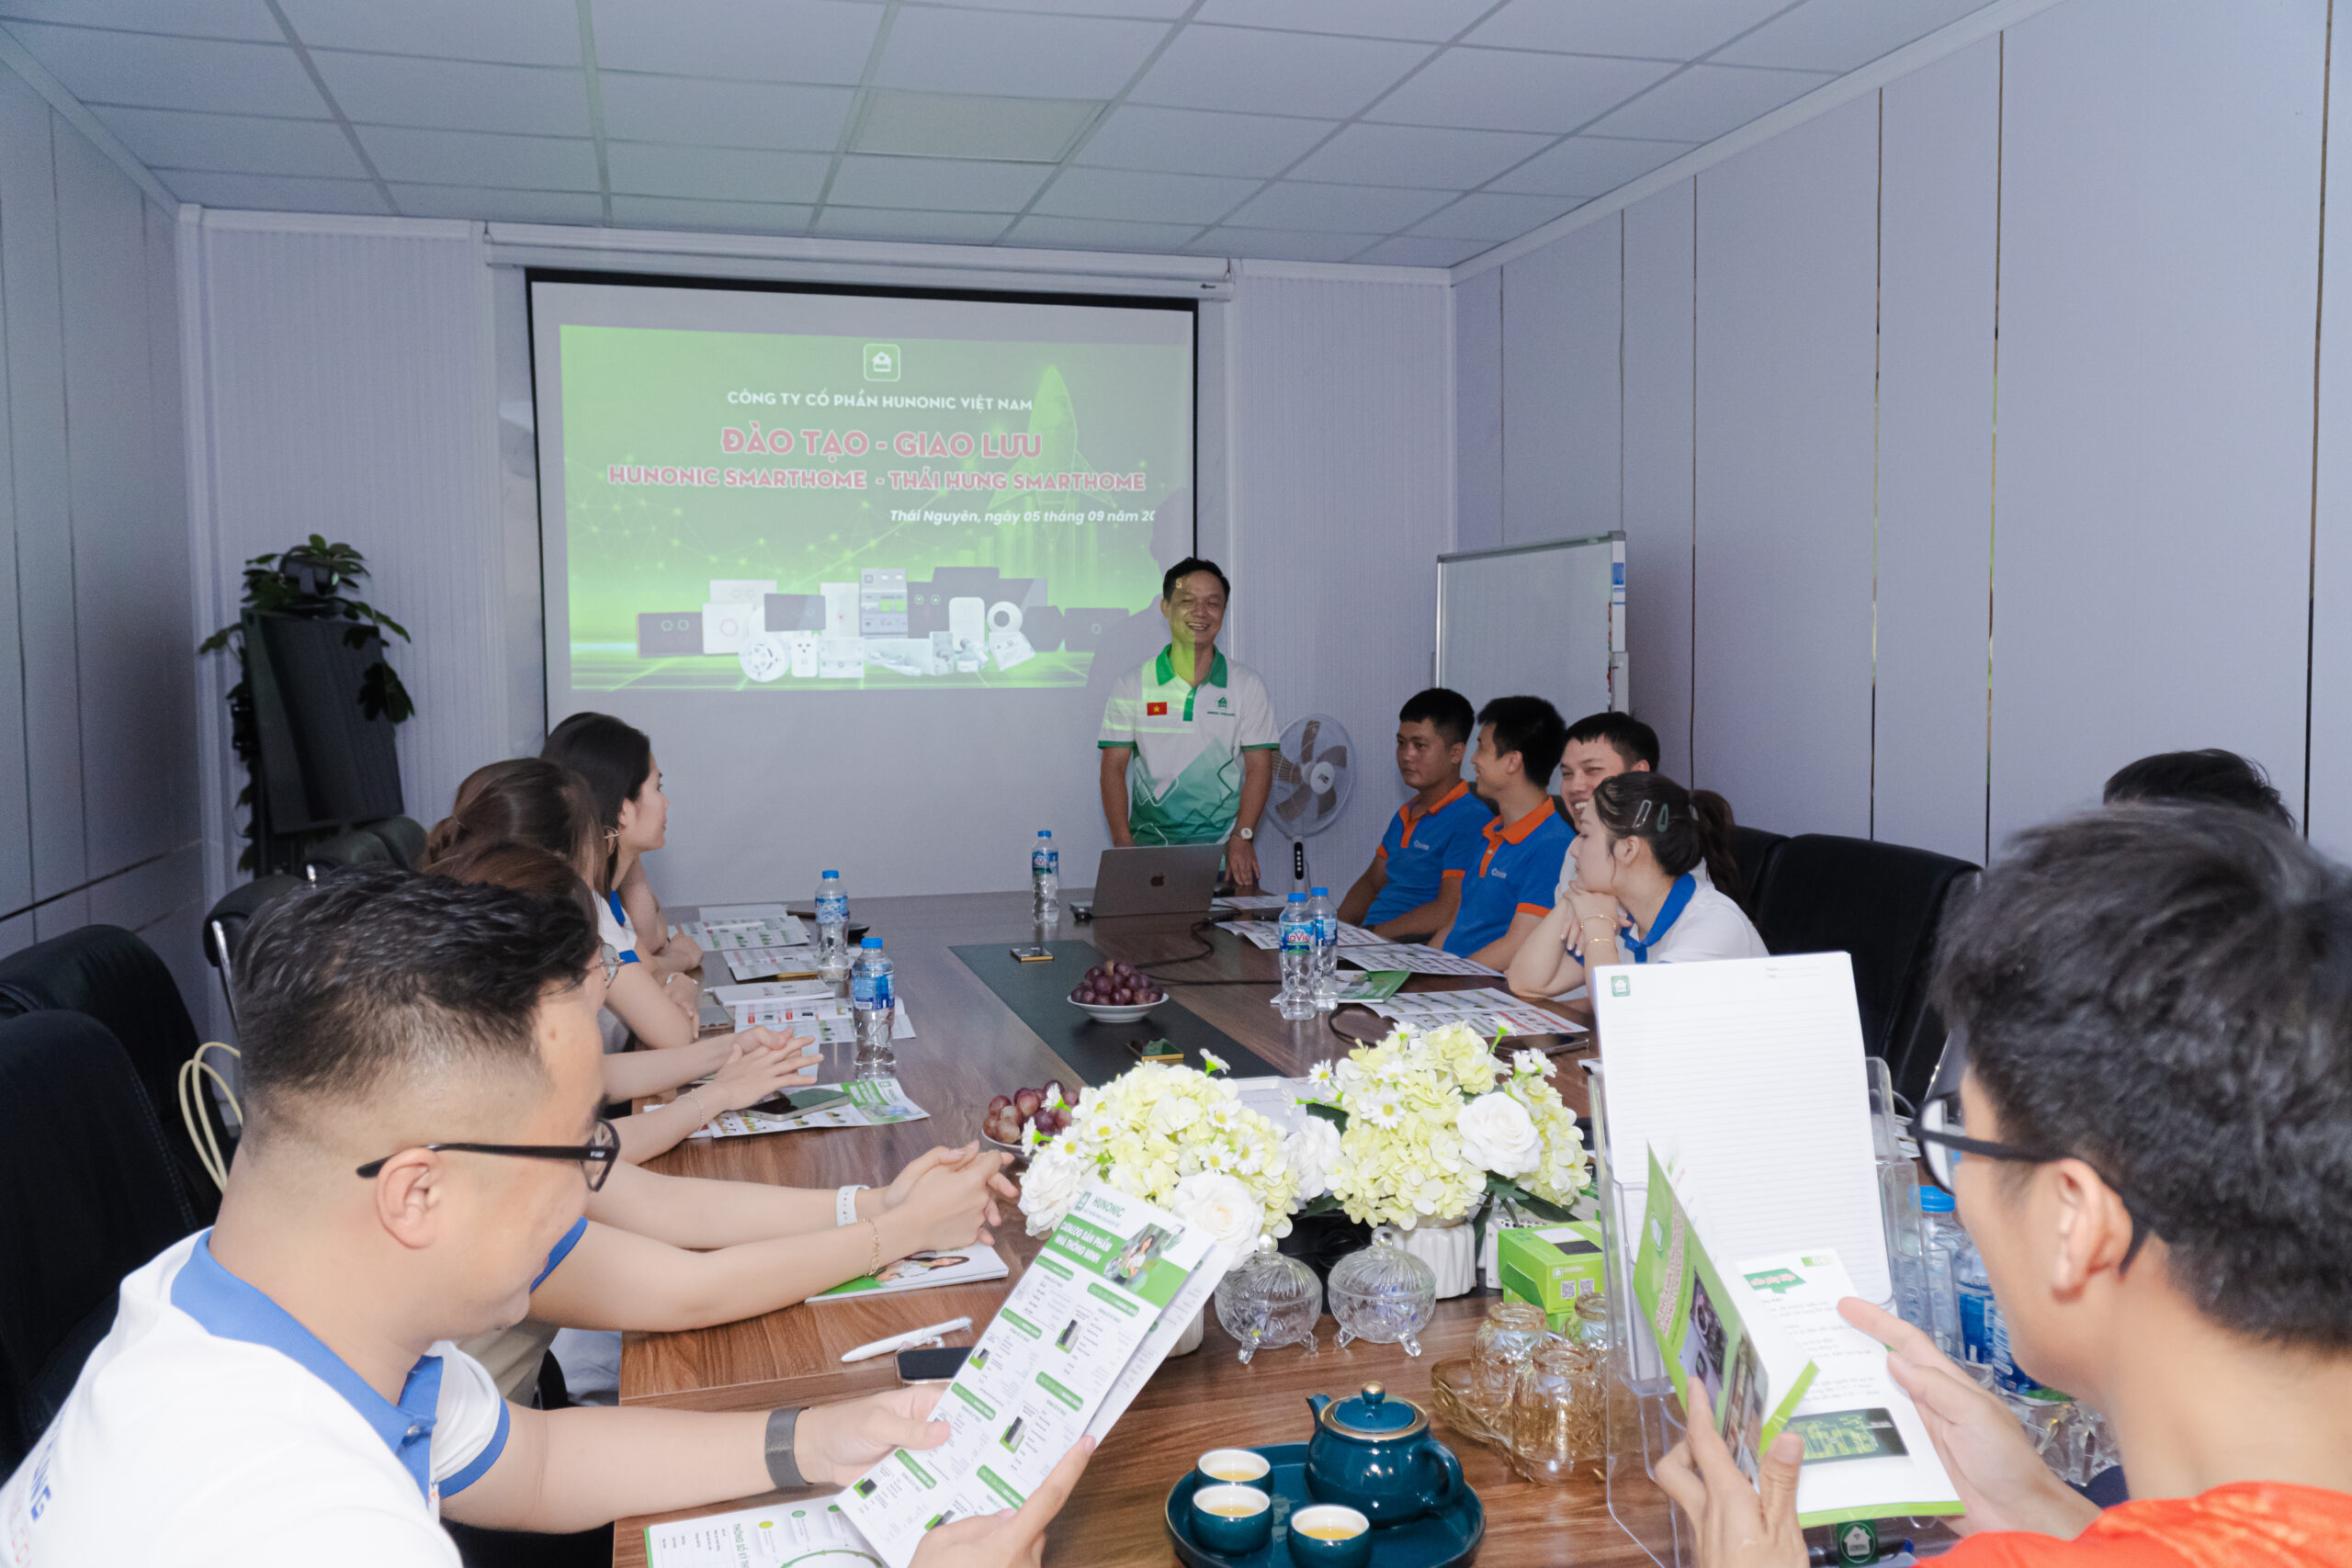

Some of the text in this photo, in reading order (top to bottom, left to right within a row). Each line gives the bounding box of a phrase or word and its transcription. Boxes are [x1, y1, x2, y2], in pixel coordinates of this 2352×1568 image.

[727, 387, 776, 405] CÔNG
[780, 392, 801, 406] TY
[882, 396, 956, 410] HUNONIC
[960, 394, 994, 413] VIỆT
[998, 398, 1033, 411] NAM
[721, 420, 794, 455] ĐÀO
[800, 428, 869, 463] TẠO
[893, 431, 974, 458] GIAO
[608, 465, 719, 486] HUNONIC
[724, 468, 867, 490] SMARTHOME
[1012, 472, 1146, 491] SMARTHOME
[889, 509, 921, 522] Thái
[984, 510, 1021, 526] ngày
[1023, 510, 1041, 523] 05
[1044, 510, 1085, 526] tháng
[1087, 510, 1104, 523] 09
[1107, 509, 1138, 522] năm
[1092, 1196, 1125, 1218] HUNONIC
